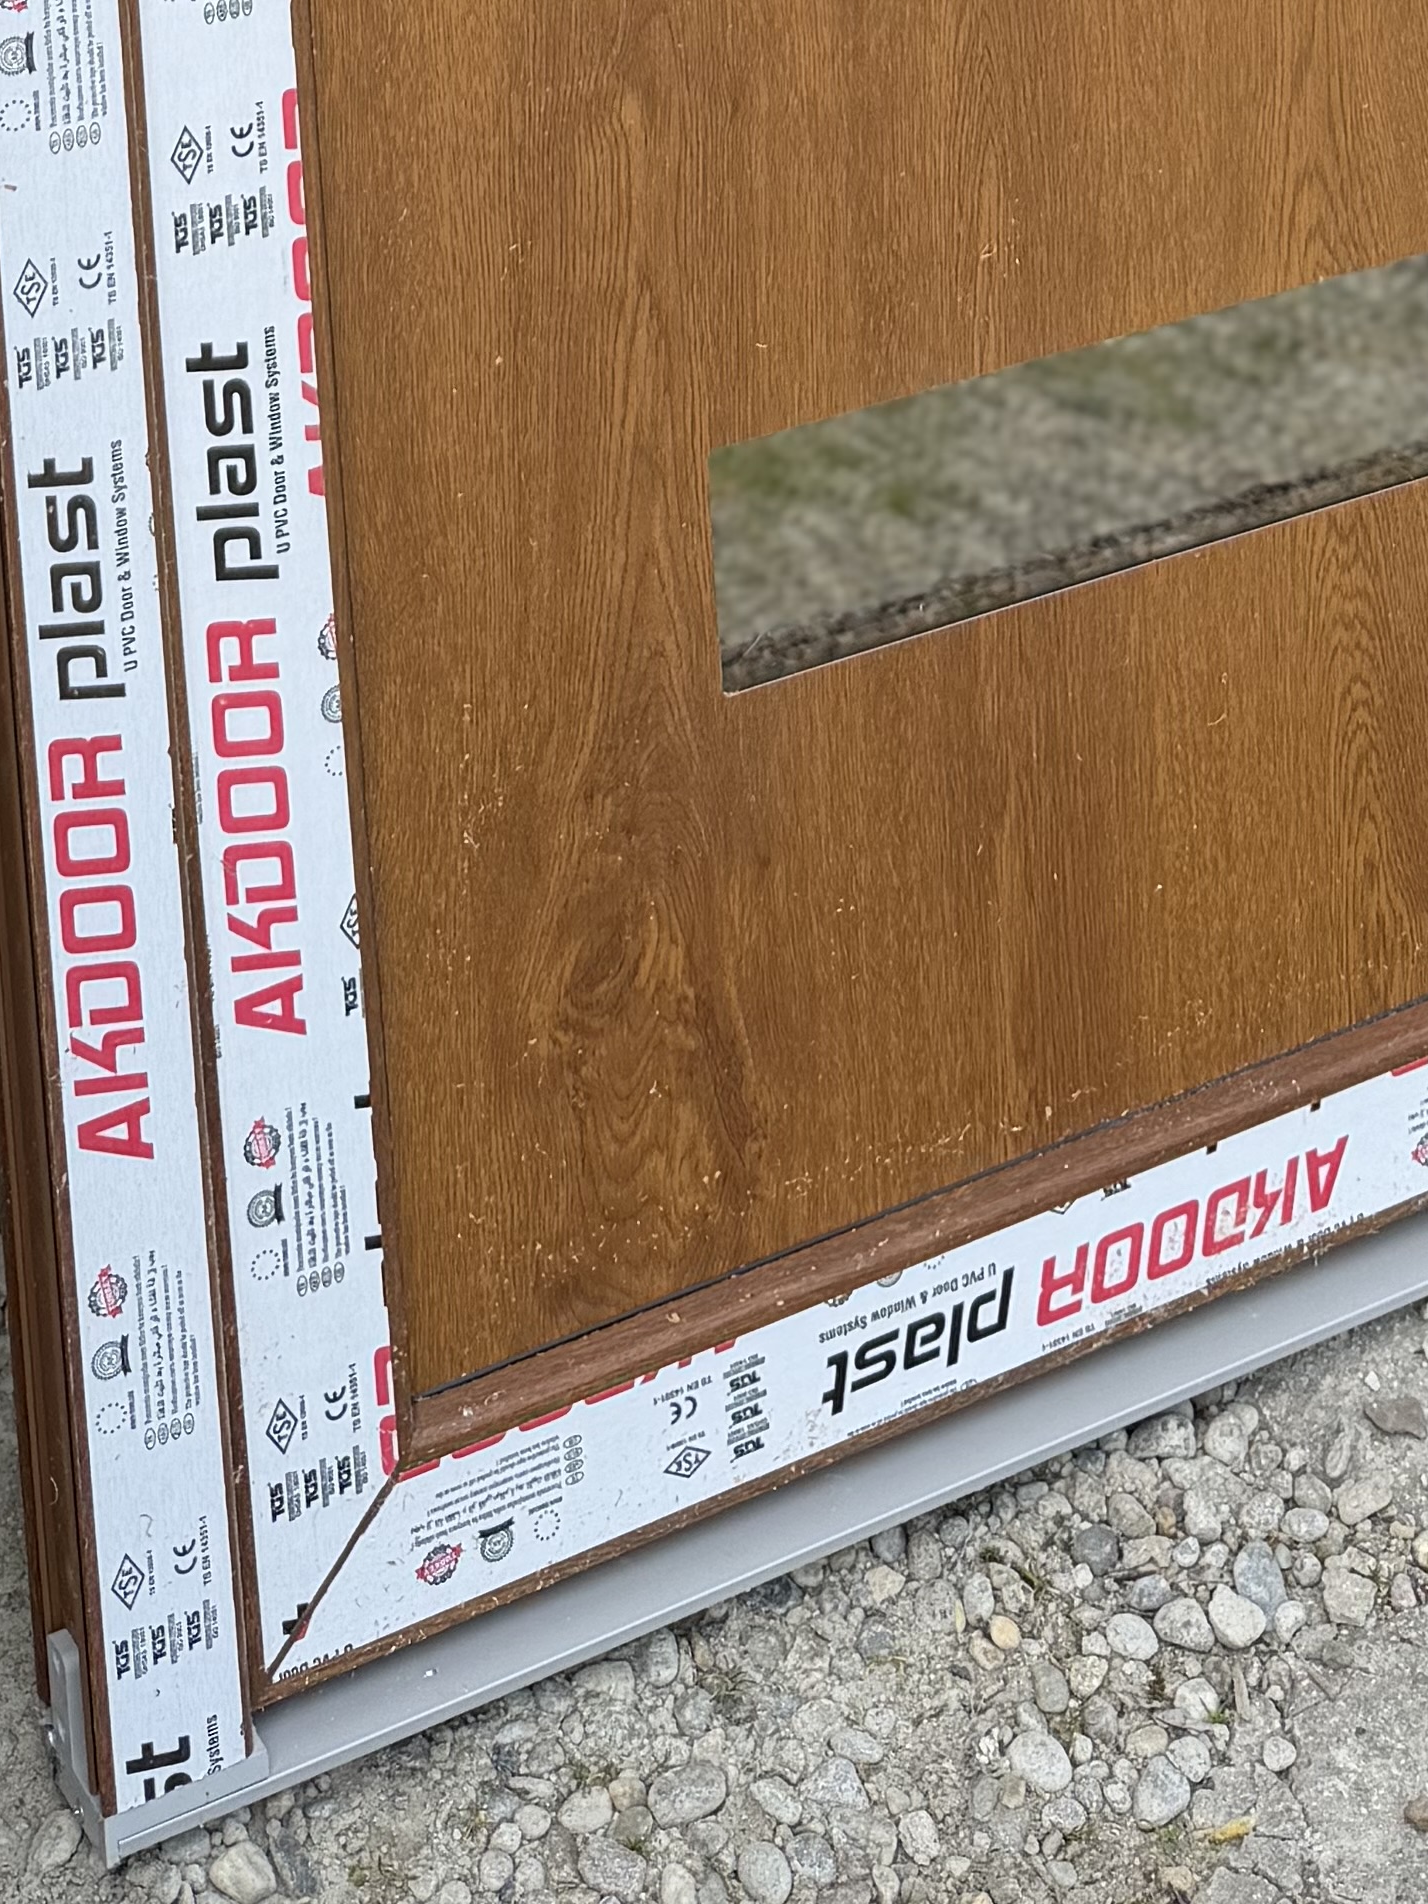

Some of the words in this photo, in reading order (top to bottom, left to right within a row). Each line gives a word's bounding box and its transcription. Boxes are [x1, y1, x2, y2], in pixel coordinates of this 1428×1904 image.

[263, 325, 281, 389] Systems
[266, 392, 283, 452] Window
[110, 439, 128, 504] Systems
[186, 343, 279, 581] plast
[269, 454, 285, 466] &
[272, 470, 287, 506] Door
[113, 507, 130, 568] Window
[273, 507, 290, 540] PVC
[276, 541, 291, 554] U
[28, 458, 125, 700] plast
[117, 569, 132, 582] &
[120, 586, 135, 623] Door
[120, 624, 137, 657] PVC
[123, 659, 138, 673] U
[205, 618, 307, 1036] AKDOOR
[46, 735, 155, 1160] AKDOOR
[1035, 1137, 1348, 1328] AKDOOR
[822, 1265, 1014, 1415] plast
